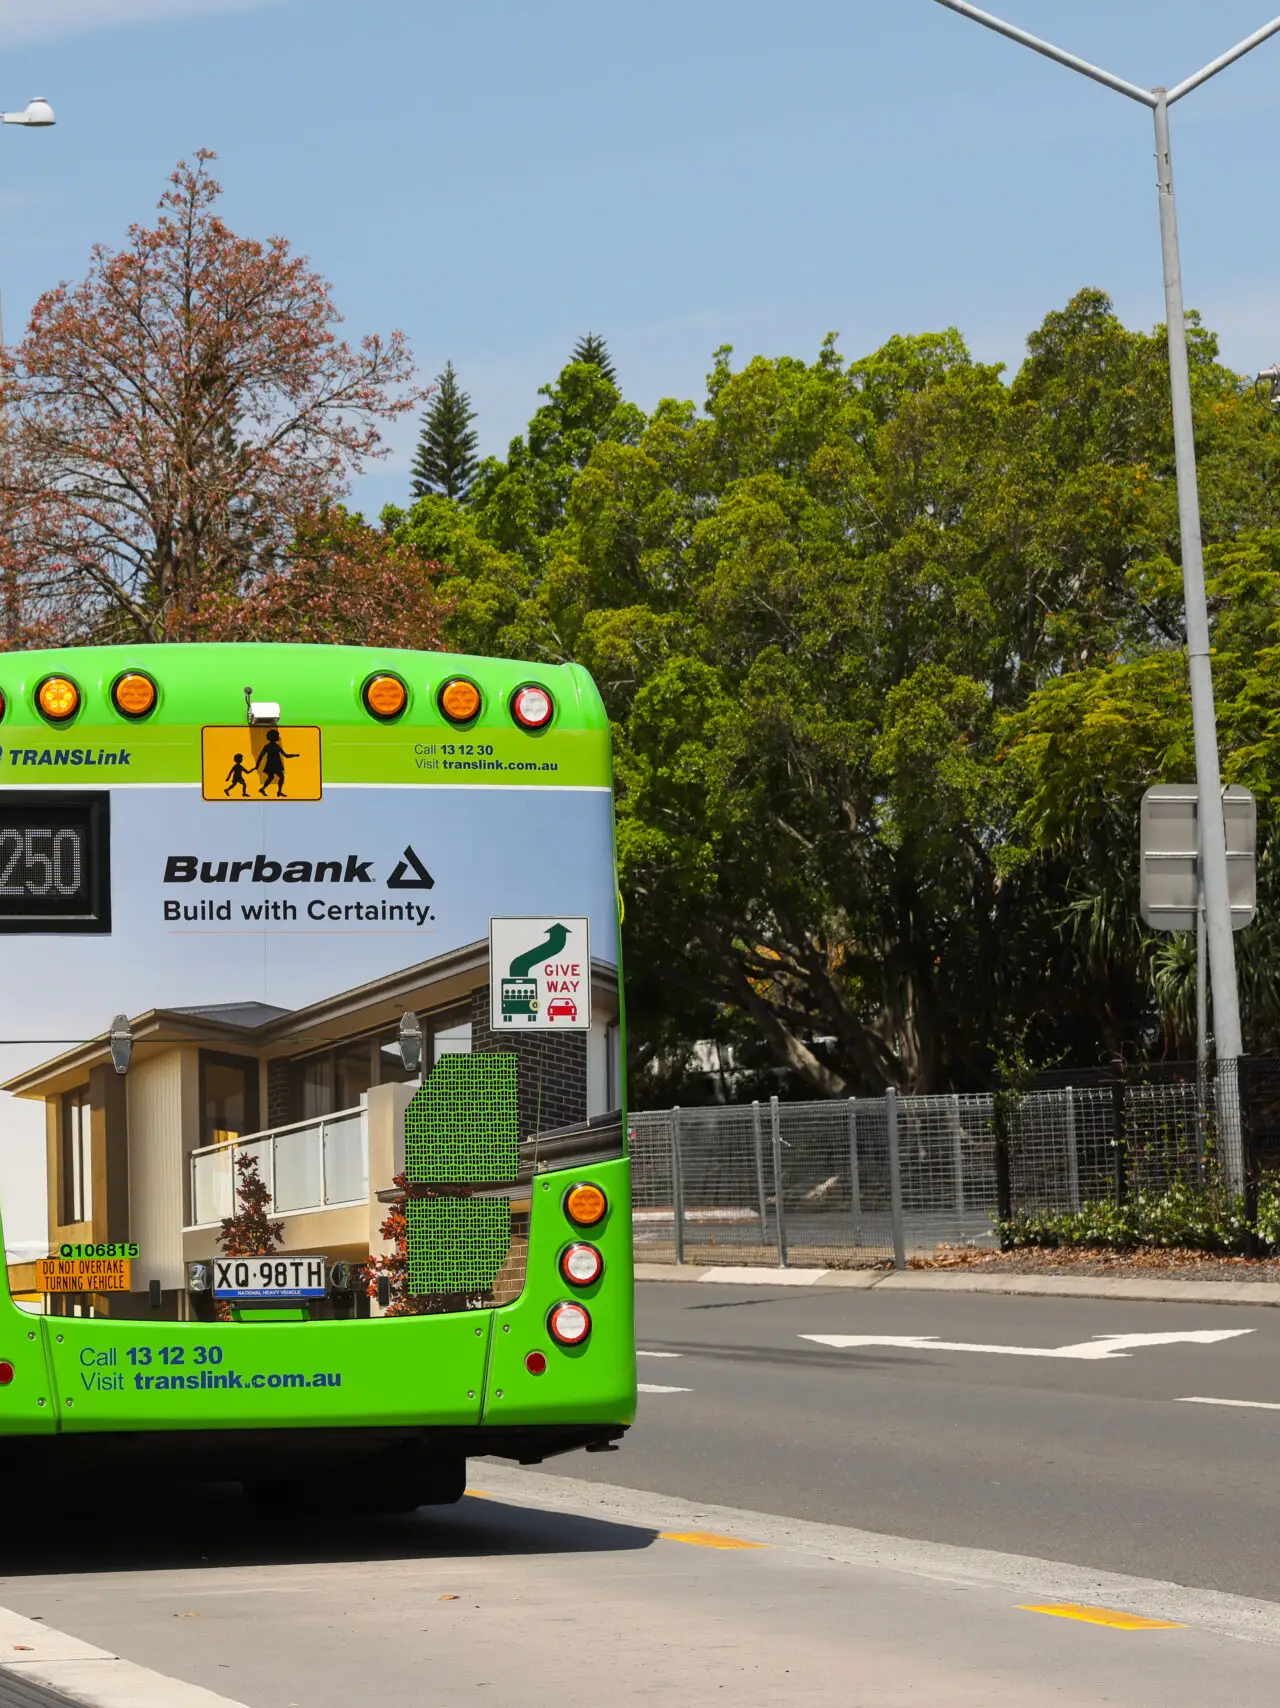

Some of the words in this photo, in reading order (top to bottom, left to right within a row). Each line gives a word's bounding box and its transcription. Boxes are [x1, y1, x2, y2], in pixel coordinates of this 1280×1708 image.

[9, 748, 132, 766] TRANSLink
[414, 744, 437, 755] Call
[440, 744, 455, 755] 13
[458, 744, 474, 756] 12
[476, 744, 494, 756] 30
[415, 758, 440, 769] Visit
[442, 759, 558, 771] translink.com.au
[163, 855, 375, 883] Burbank
[163, 900, 232, 921] Build
[240, 900, 297, 921] with
[307, 900, 436, 926] Certainty.
[544, 964, 580, 976] GIVE
[546, 981, 580, 993] WAY
[60, 1243, 139, 1257] Q106815
[42, 1261, 55, 1275] DO
[58, 1260, 76, 1275] NOT
[79, 1259, 124, 1274] OVERTAKE
[45, 1275, 83, 1290] TURNING
[87, 1274, 124, 1289] VEHICLE
[79, 1347, 117, 1366] Call
[125, 1347, 152, 1366] 13
[158, 1346, 185, 1365] 12
[192, 1345, 223, 1364] 30
[80, 1372, 125, 1391] Visit
[134, 1370, 342, 1390] translink.com.au
